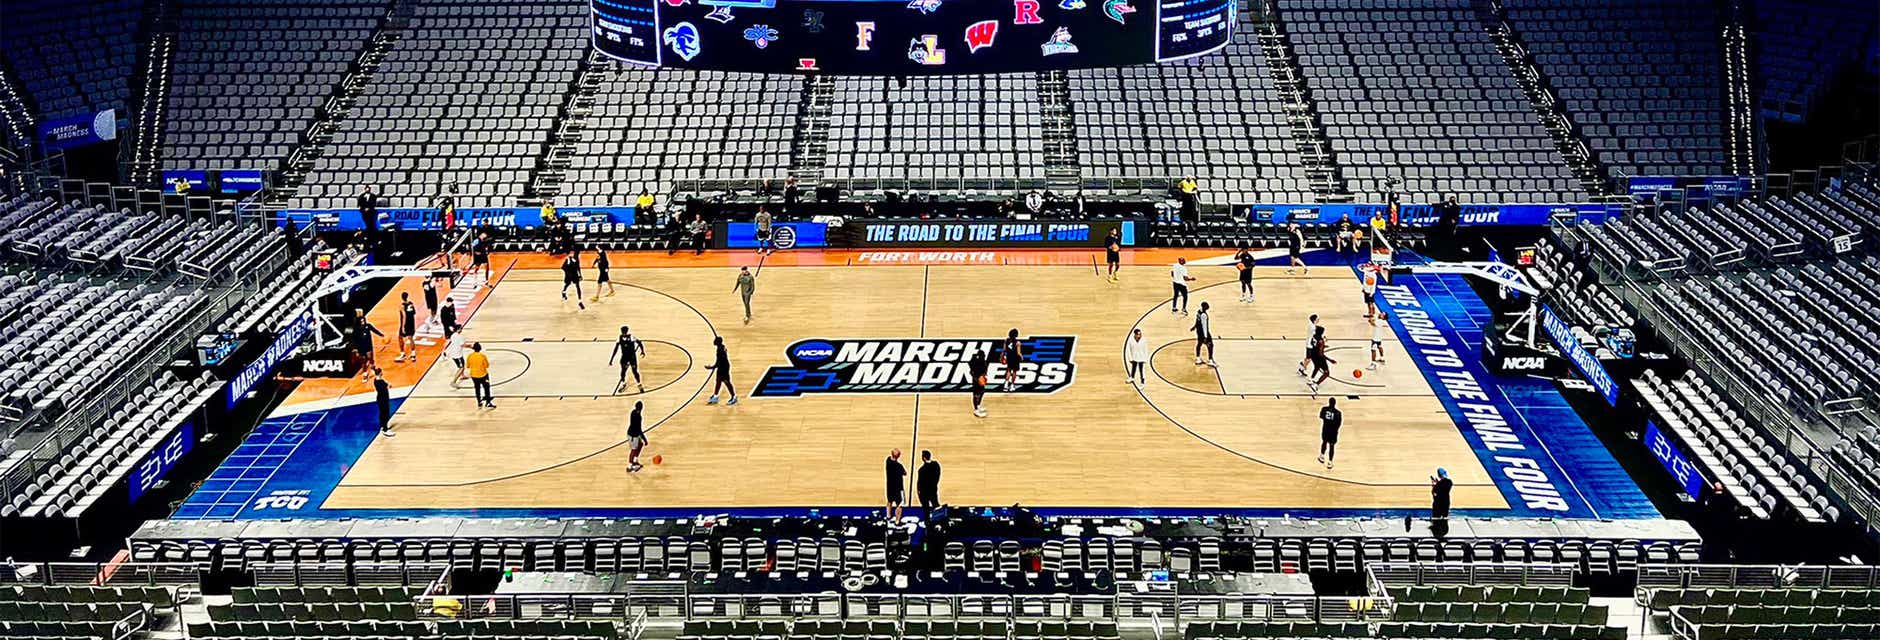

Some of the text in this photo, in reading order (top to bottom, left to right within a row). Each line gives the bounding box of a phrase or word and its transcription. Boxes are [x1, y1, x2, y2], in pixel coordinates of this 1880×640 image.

[855, 21, 875, 50] F
[964, 20, 999, 54] W
[1458, 206, 1500, 223] OUR
[866, 224, 1090, 242] THE ROAD TO THE FINAL FOUR
[859, 252, 995, 262] FORT WORTH
[1377, 285, 1422, 307] THE
[1393, 308, 1448, 346] ROAD
[796, 349, 833, 357] NCAA
[834, 342, 993, 363] MARCH
[1420, 348, 1464, 368] TO
[1502, 357, 1545, 369] NCAA
[1543, 309, 1574, 354] MARCH
[1571, 347, 1613, 396] MADNESS
[303, 360, 343, 372] NCAA
[231, 358, 266, 402] MARCH
[1436, 371, 1490, 402] THE
[1325, 410, 1334, 420] 21
[1457, 403, 1526, 451] FINAL
[1494, 456, 1570, 511] FOUR
[253, 496, 309, 511] TCU
